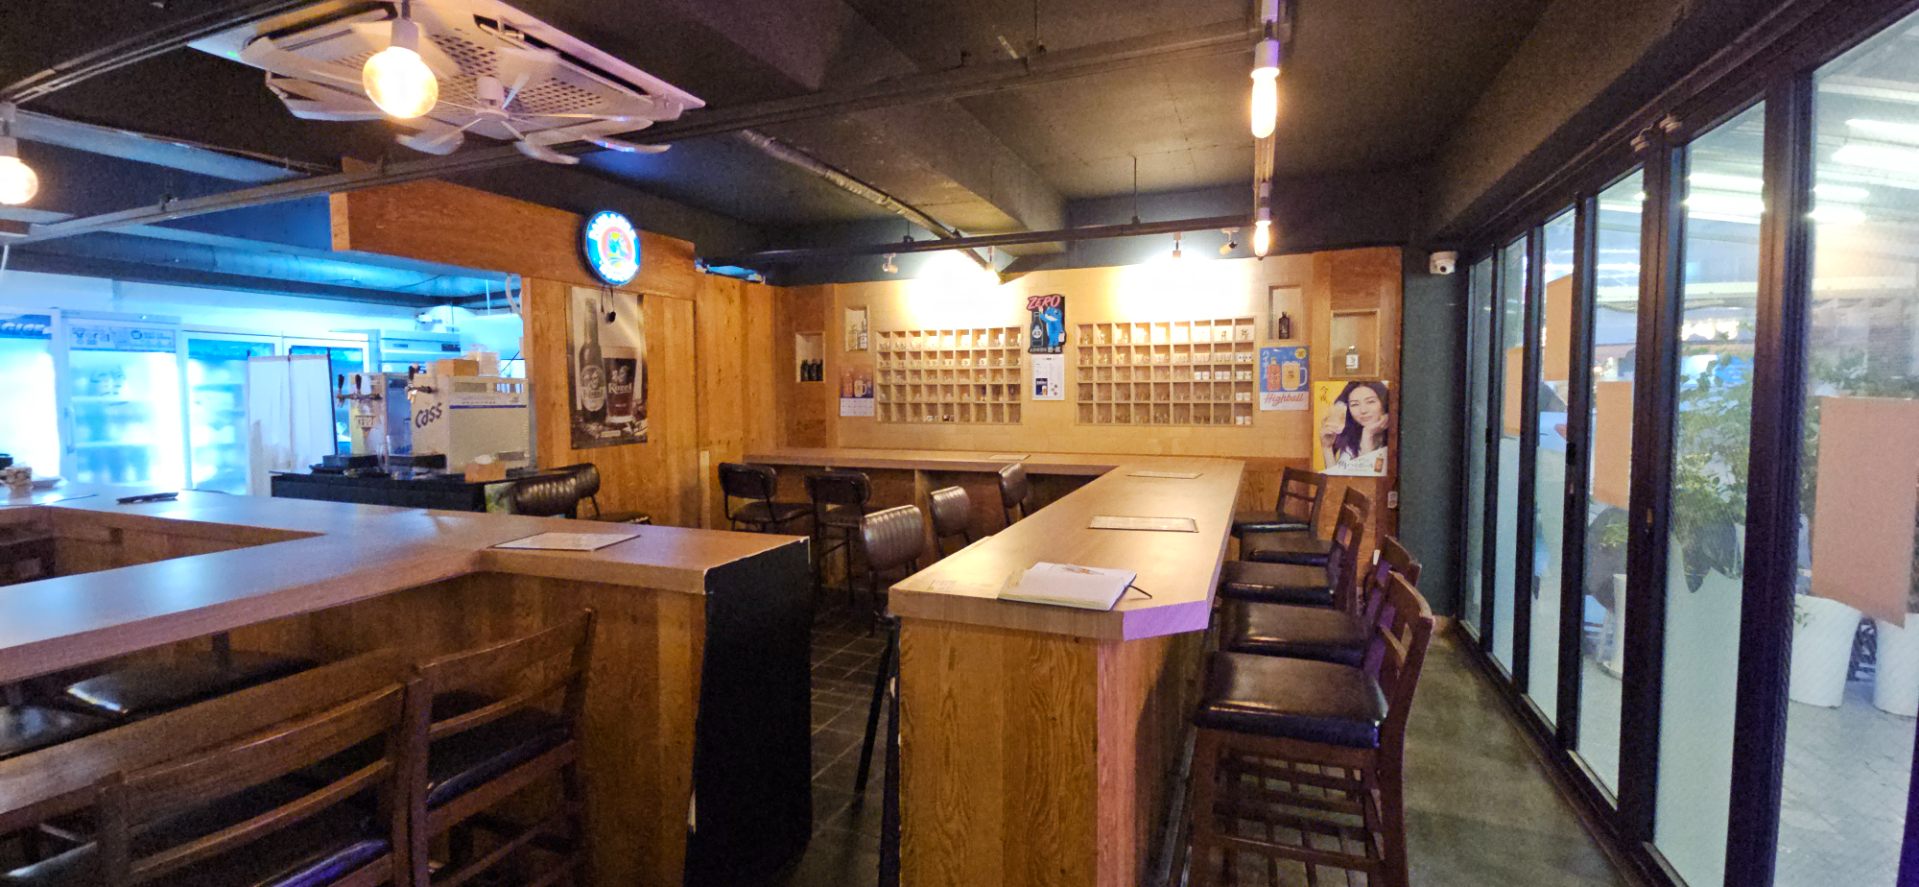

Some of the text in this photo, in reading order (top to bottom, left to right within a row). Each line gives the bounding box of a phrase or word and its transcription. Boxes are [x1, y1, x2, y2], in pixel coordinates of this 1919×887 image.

[1028, 295, 1061, 309] ZERO
[608, 383, 632, 394] Kozel
[1265, 393, 1304, 407] Highball
